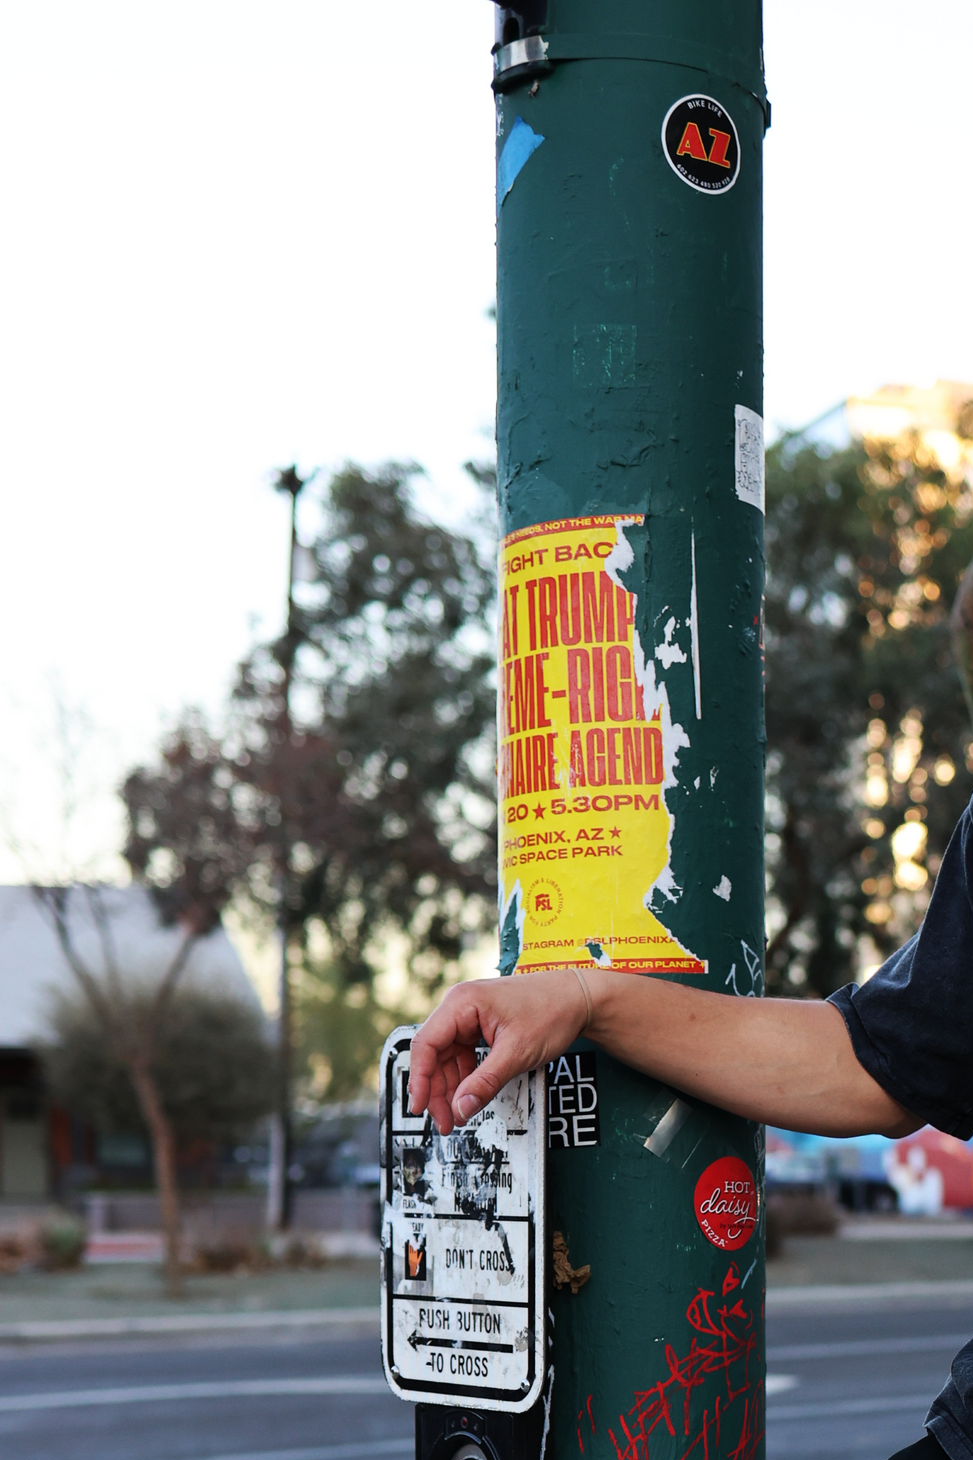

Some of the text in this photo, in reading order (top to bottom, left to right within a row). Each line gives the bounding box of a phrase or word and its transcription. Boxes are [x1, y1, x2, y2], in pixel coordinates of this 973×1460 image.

[687, 100, 723, 118] BIKE LIFE
[676, 121, 731, 169] AZ
[676, 164, 688, 176] 602
[688, 174, 699, 185] 623
[545, 520, 567, 531] NOT
[569, 517, 592, 528] THE
[555, 541, 615, 563] BAC
[525, 570, 634, 652] TRUMP
[507, 803, 529, 824] 20
[550, 794, 659, 815] 5.30PM
[504, 828, 604, 853] PHOENIX, AZ
[519, 848, 568, 865] SPACE
[572, 845, 623, 858] PARK
[535, 894, 553, 912] PSL
[611, 961, 627, 970] OF
[628, 961, 653, 969] OUR
[655, 960, 696, 968] PLANET
[549, 1055, 595, 1084] AL
[724, 1181, 751, 1194] HOT
[700, 1187, 755, 1224] daisy
[701, 1218, 726, 1247] PIZZA
[445, 1248, 475, 1270] DON'T
[419, 1308, 501, 1334] PUSH BUTTON
[450, 1354, 489, 1377] CROSS
